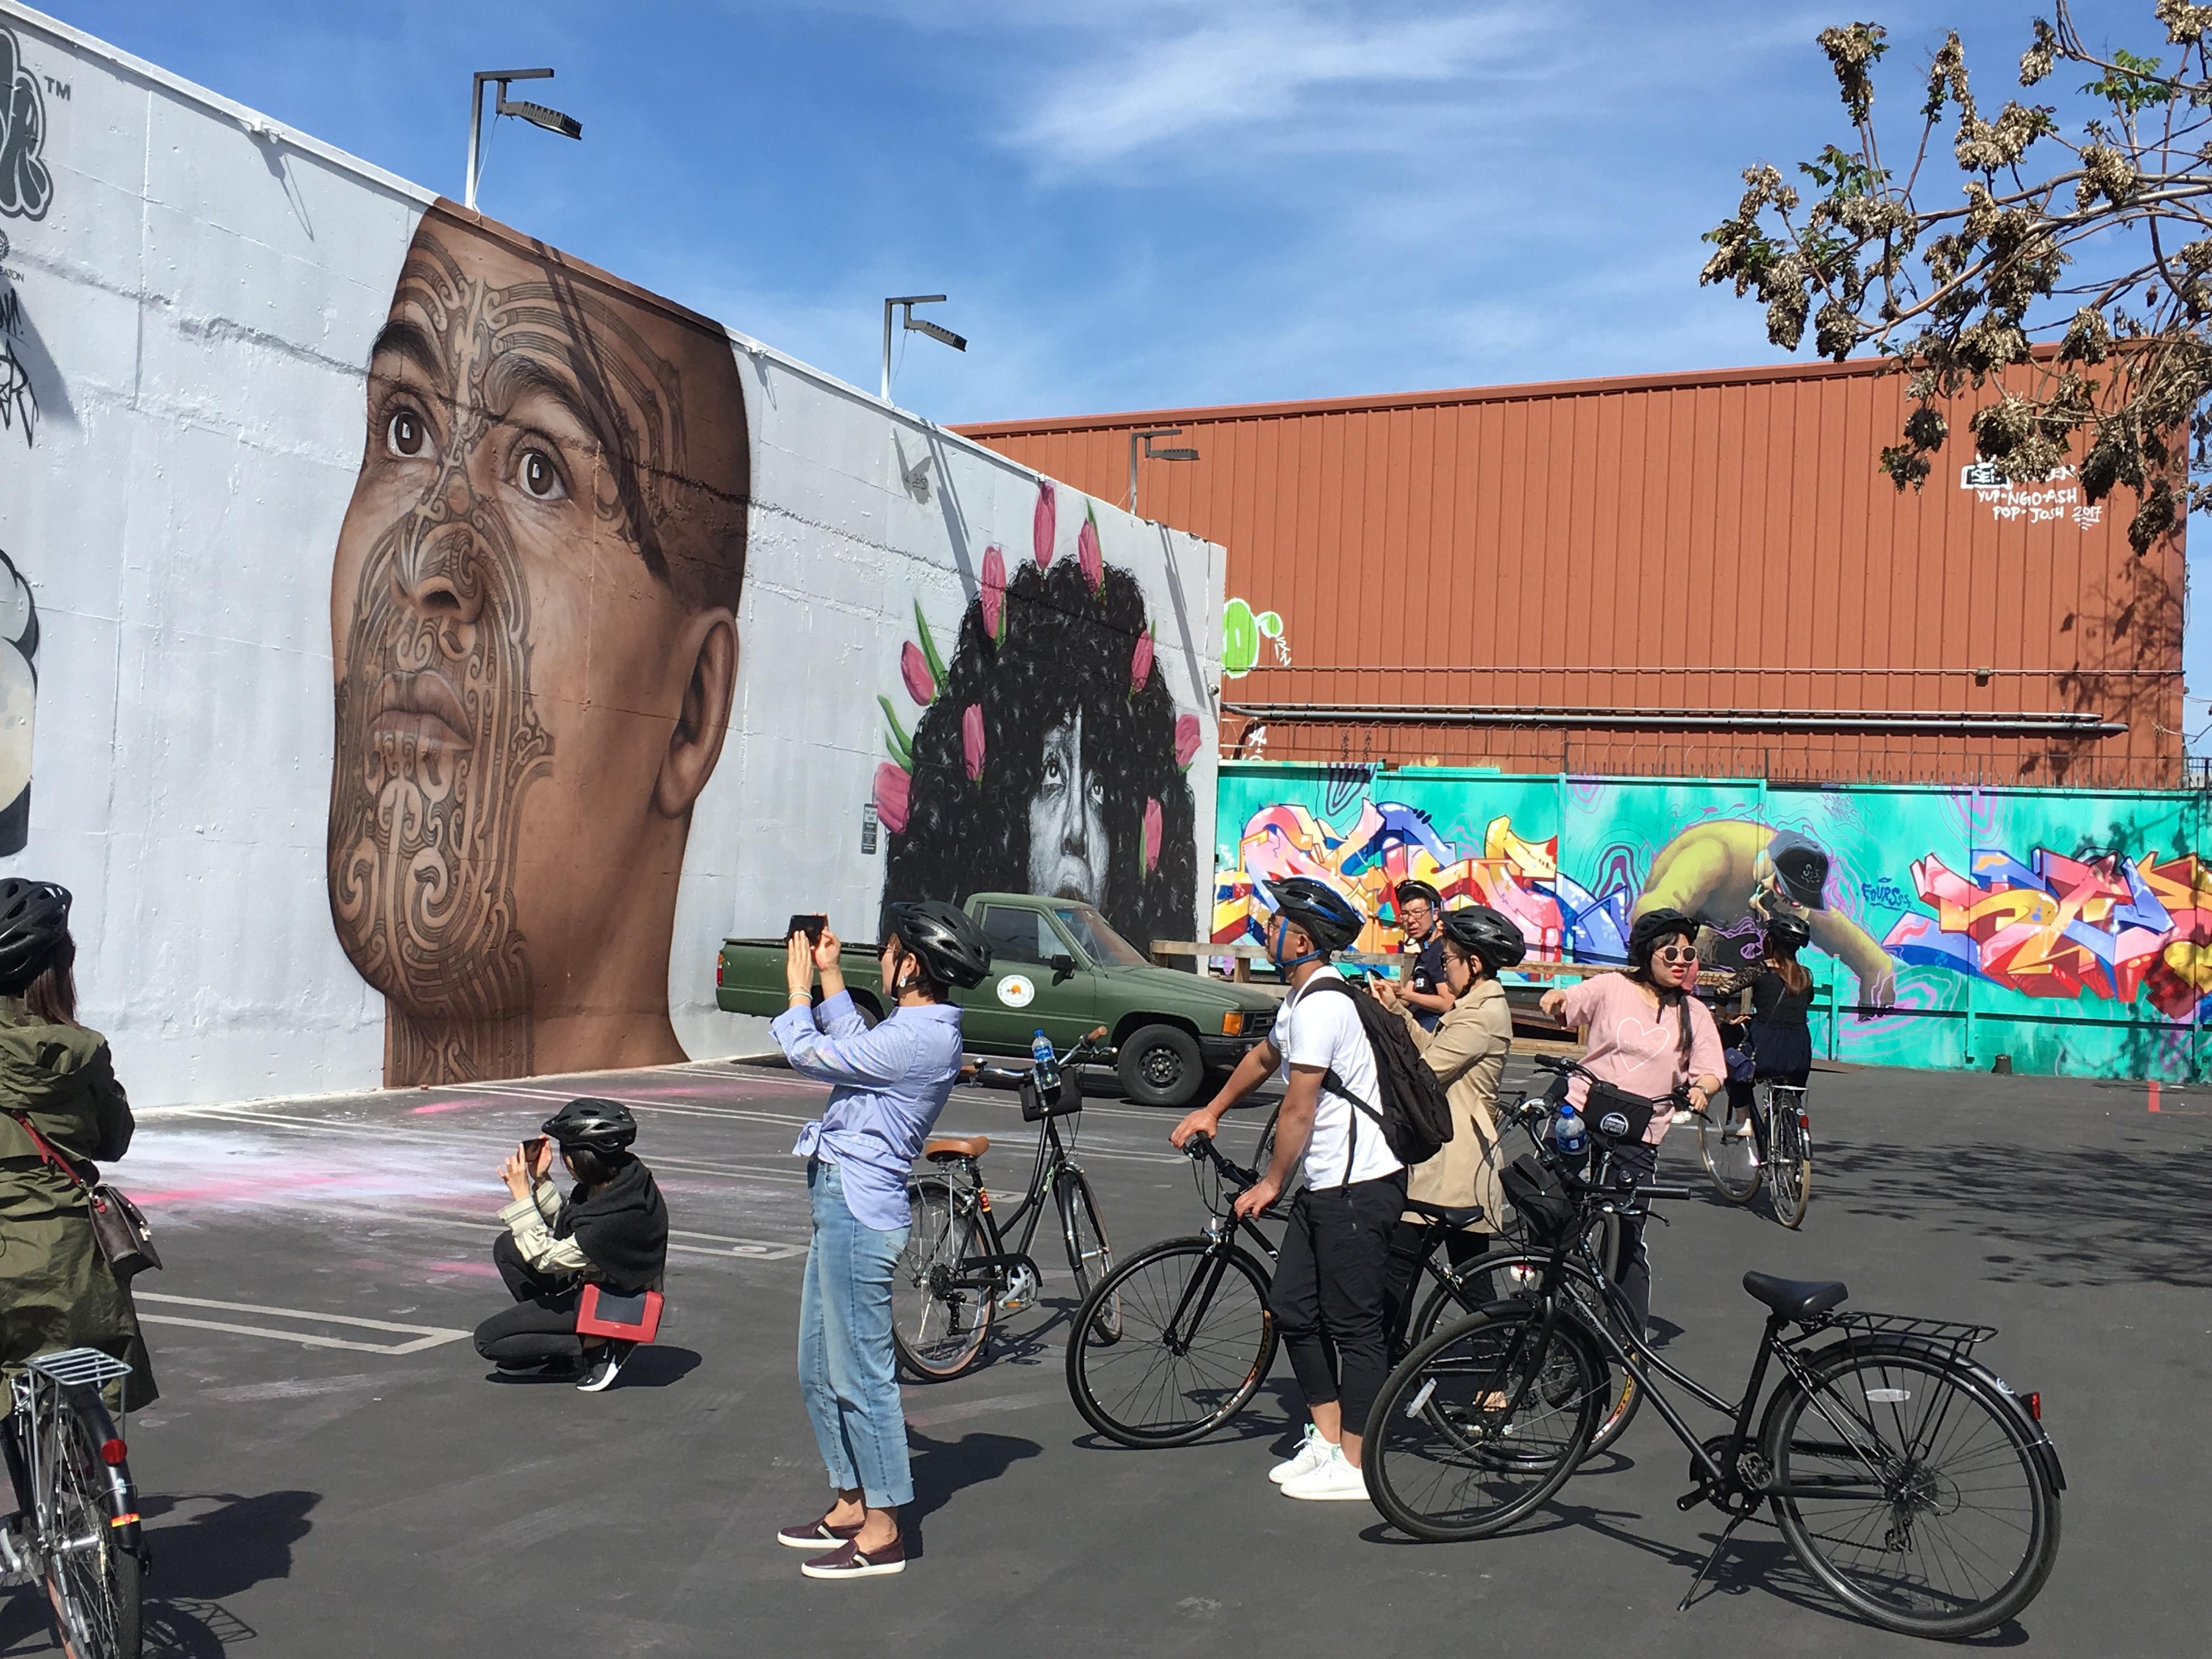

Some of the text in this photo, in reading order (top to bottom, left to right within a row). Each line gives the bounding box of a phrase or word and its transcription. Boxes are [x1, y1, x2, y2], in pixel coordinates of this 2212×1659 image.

[44, 76, 71, 101] TM
[2029, 506, 2064, 523] JOSH
[2071, 505, 2103, 520] 2017
